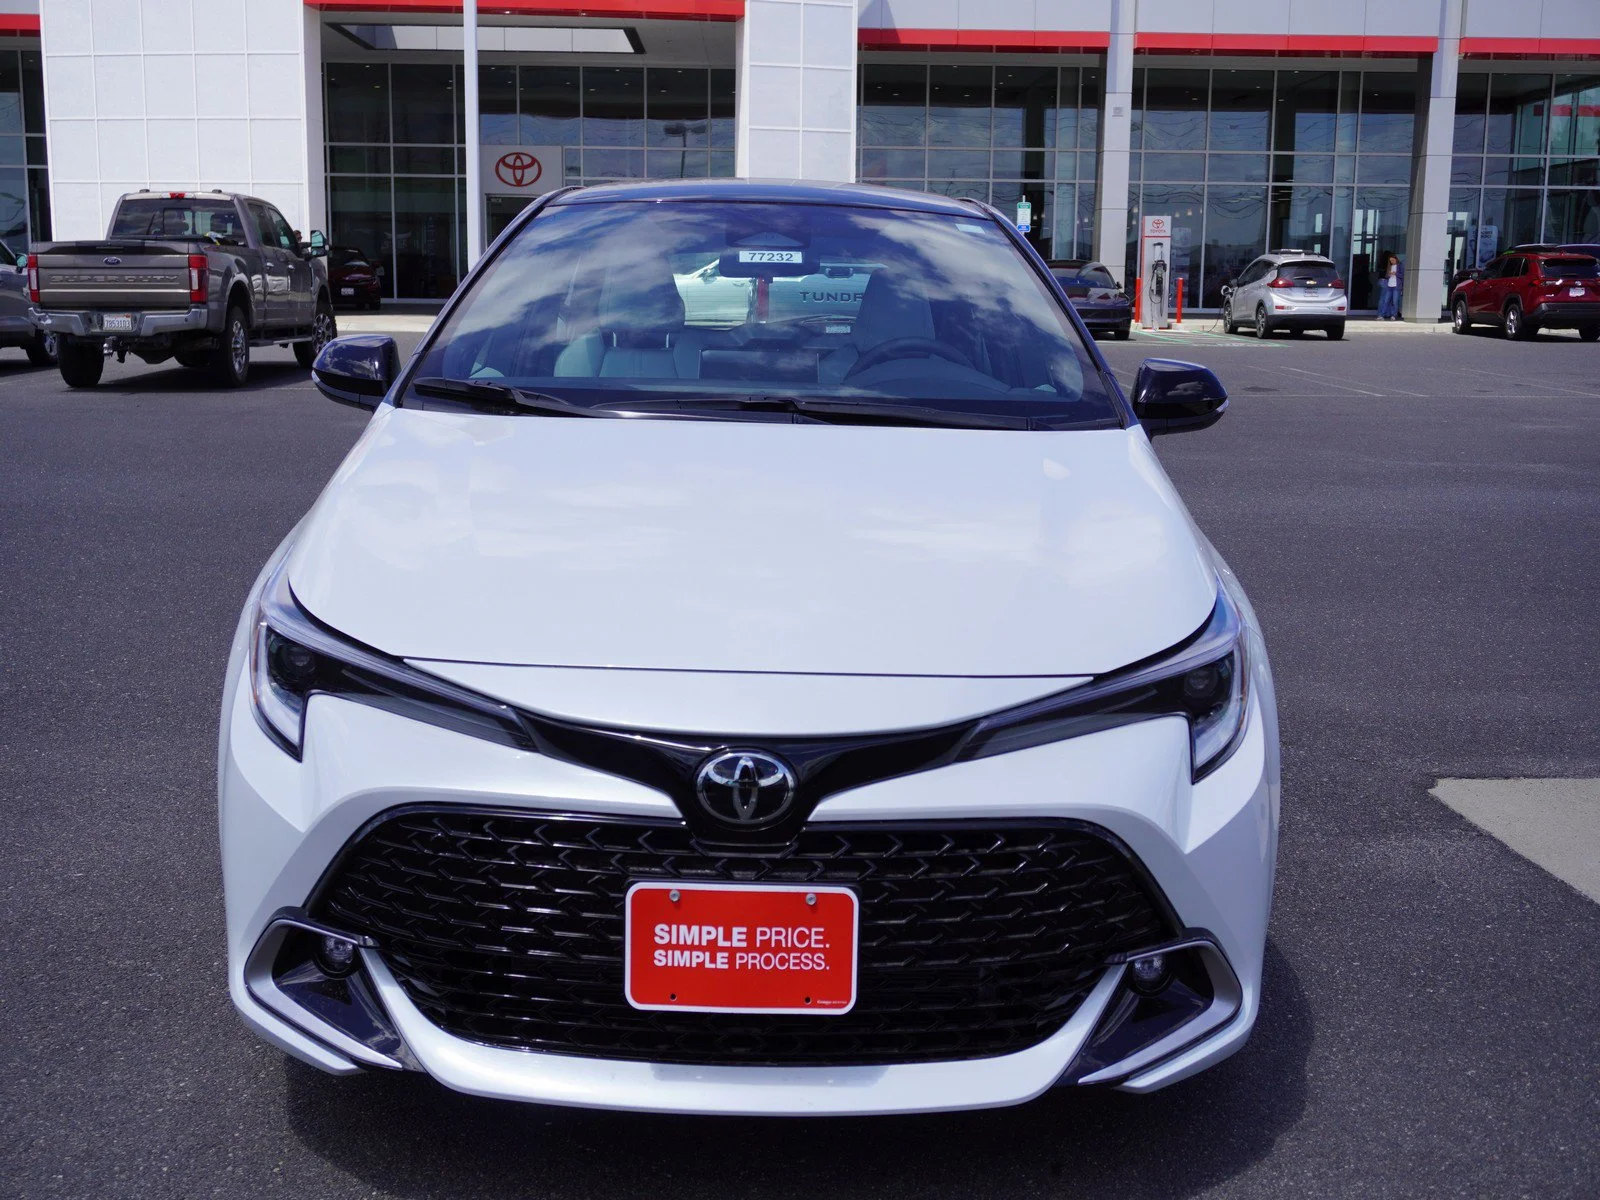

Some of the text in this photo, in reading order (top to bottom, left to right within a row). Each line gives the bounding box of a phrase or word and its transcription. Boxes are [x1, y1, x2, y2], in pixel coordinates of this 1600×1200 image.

[749, 252, 794, 262] 77232
[50, 274, 178, 282] SUPER DUTY
[799, 291, 863, 302] TUNDR
[654, 923, 830, 949] SIMPLE PRICE.
[653, 949, 830, 971] SIMPLE PROCESS.
